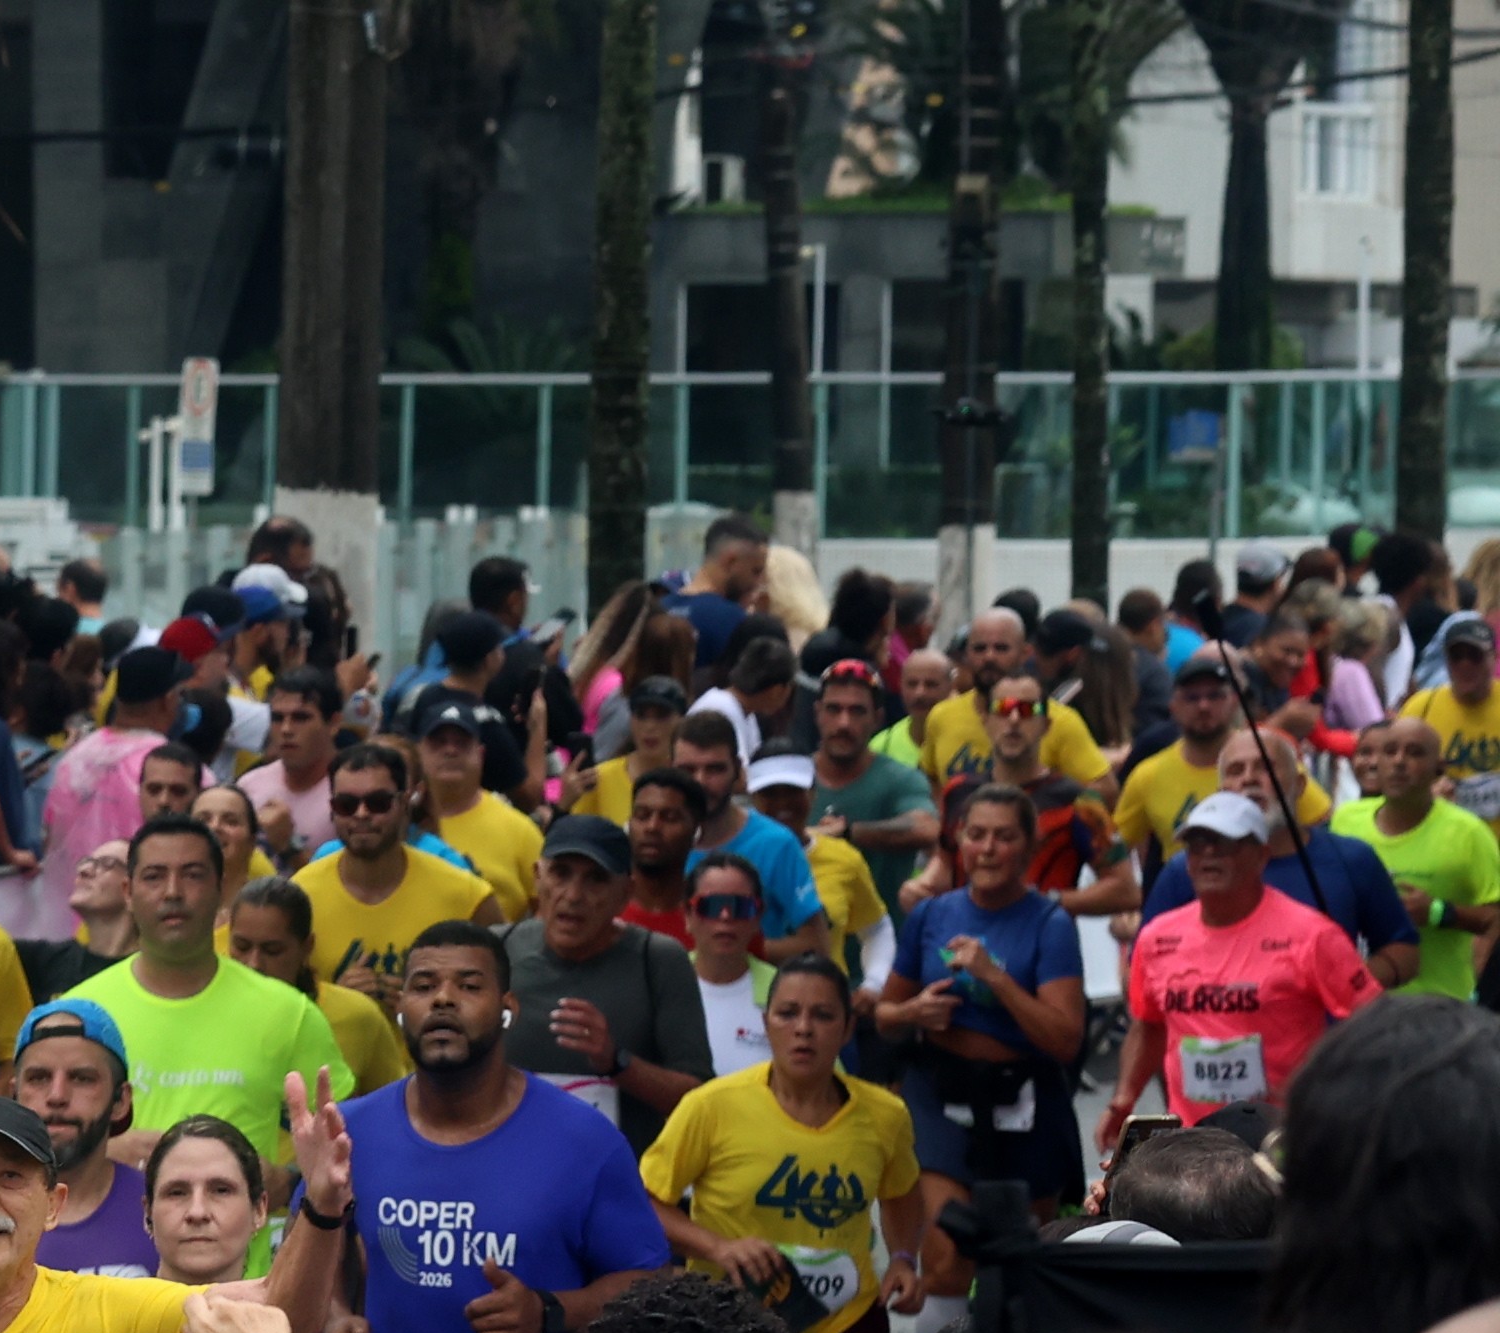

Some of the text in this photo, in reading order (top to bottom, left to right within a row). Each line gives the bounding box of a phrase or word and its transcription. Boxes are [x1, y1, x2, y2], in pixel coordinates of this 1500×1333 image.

[378, 1197, 476, 1229] COPER
[418, 1230, 517, 1267] 10 KM
[419, 1272, 453, 1287] 2026
